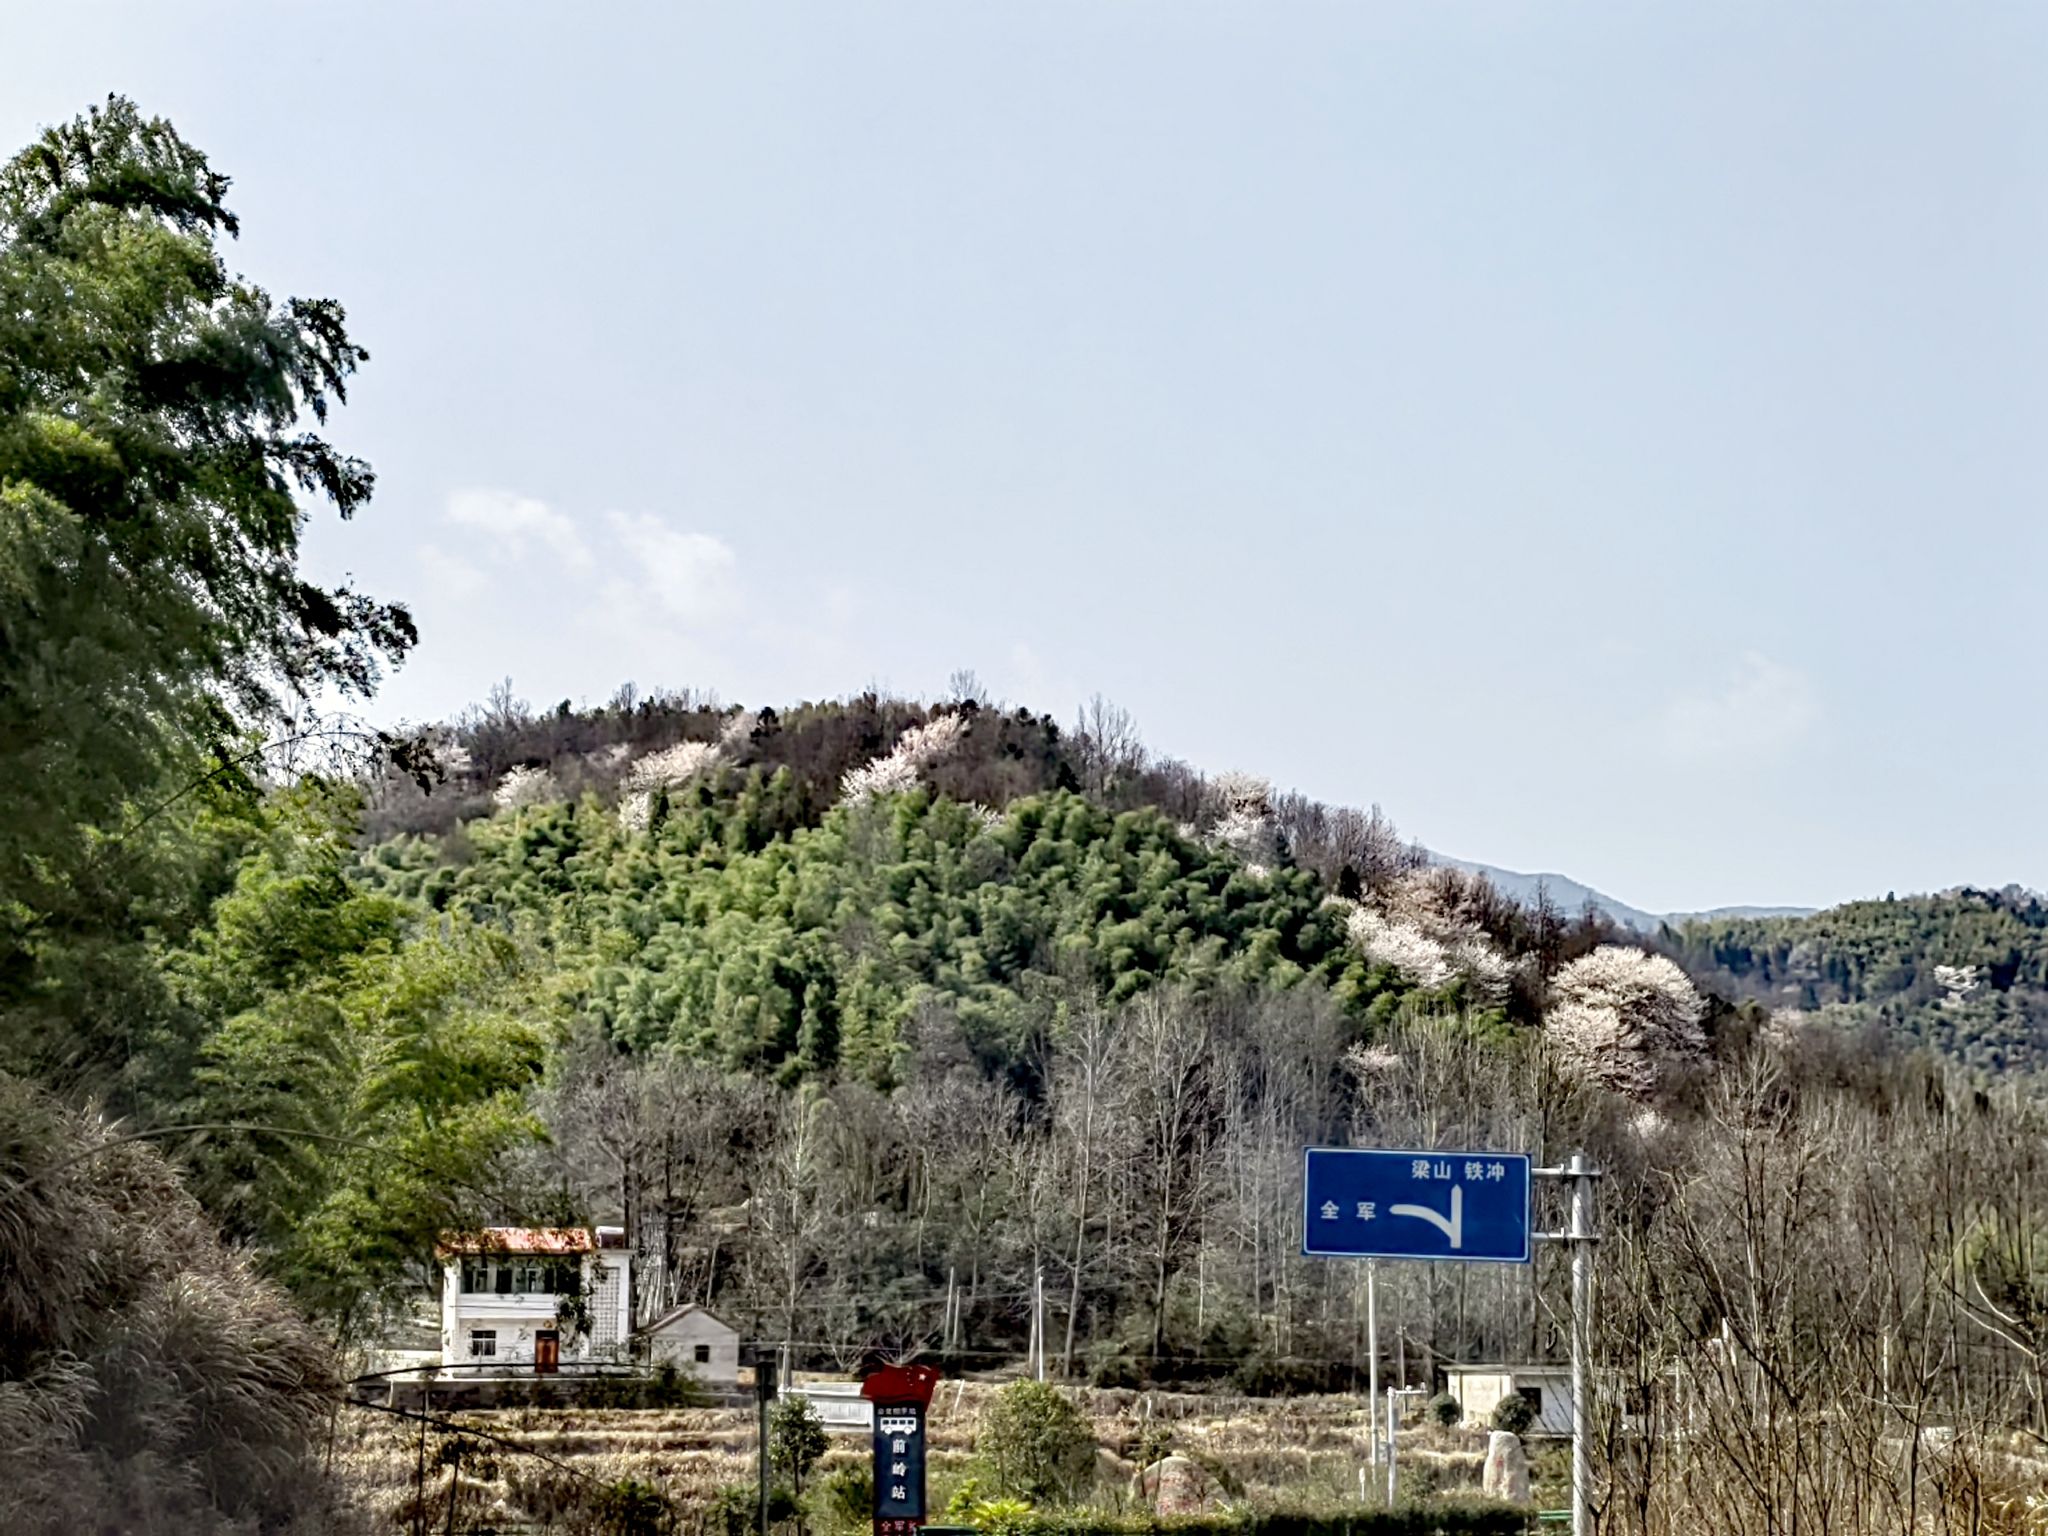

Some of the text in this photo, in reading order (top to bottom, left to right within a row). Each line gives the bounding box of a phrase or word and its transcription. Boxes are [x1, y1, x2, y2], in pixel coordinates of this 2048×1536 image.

[1412, 1160, 1505, 1182] 梁山 铁冲
[1320, 1200, 1376, 1221] 全军
